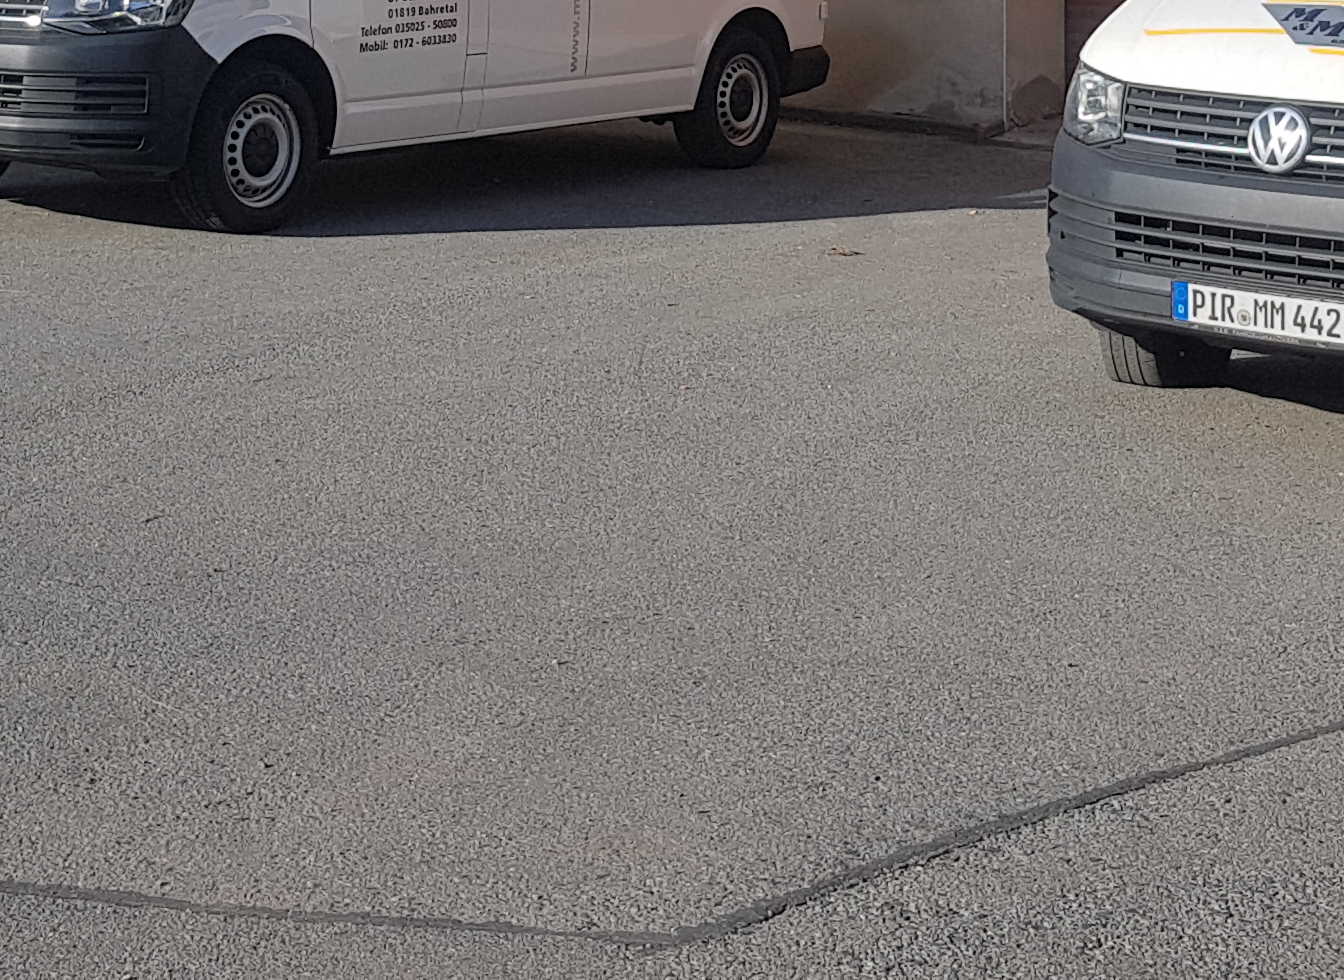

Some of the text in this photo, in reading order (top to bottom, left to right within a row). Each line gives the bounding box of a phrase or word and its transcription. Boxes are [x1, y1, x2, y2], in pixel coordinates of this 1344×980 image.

[388, 2, 457, 18] 01819 Bahretal
[361, 24, 392, 37] Telefon
[395, 21, 425, 33] 035025
[359, 40, 389, 53] Mobil:
[393, 38, 414, 49] 0172
[1192, 288, 1236, 324] PIR
[1253, 298, 1286, 331] MM
[1292, 304, 1342, 339] 442
